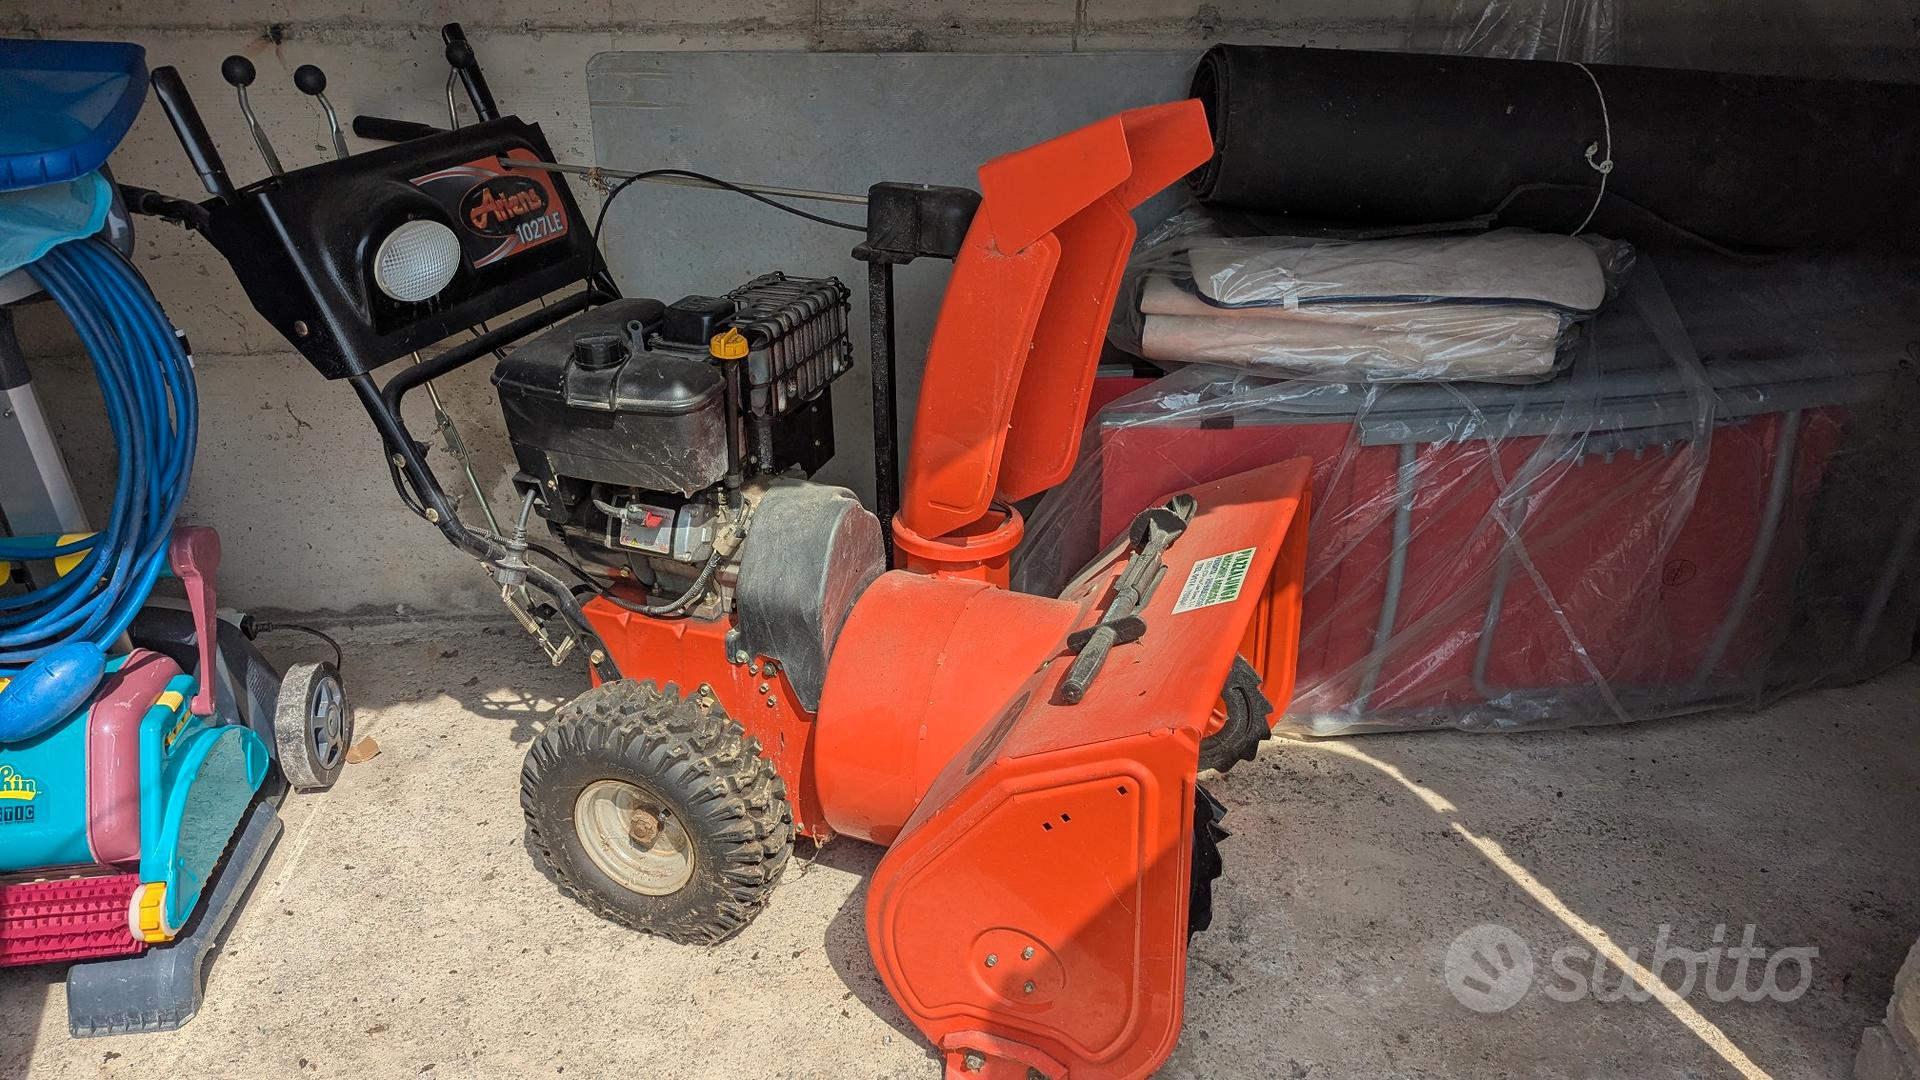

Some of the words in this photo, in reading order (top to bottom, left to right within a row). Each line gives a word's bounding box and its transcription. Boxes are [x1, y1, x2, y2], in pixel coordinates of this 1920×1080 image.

[470, 187, 541, 229] Ariens
[516, 212, 563, 244] 1027LE
[0, 805, 34, 821] TIC
